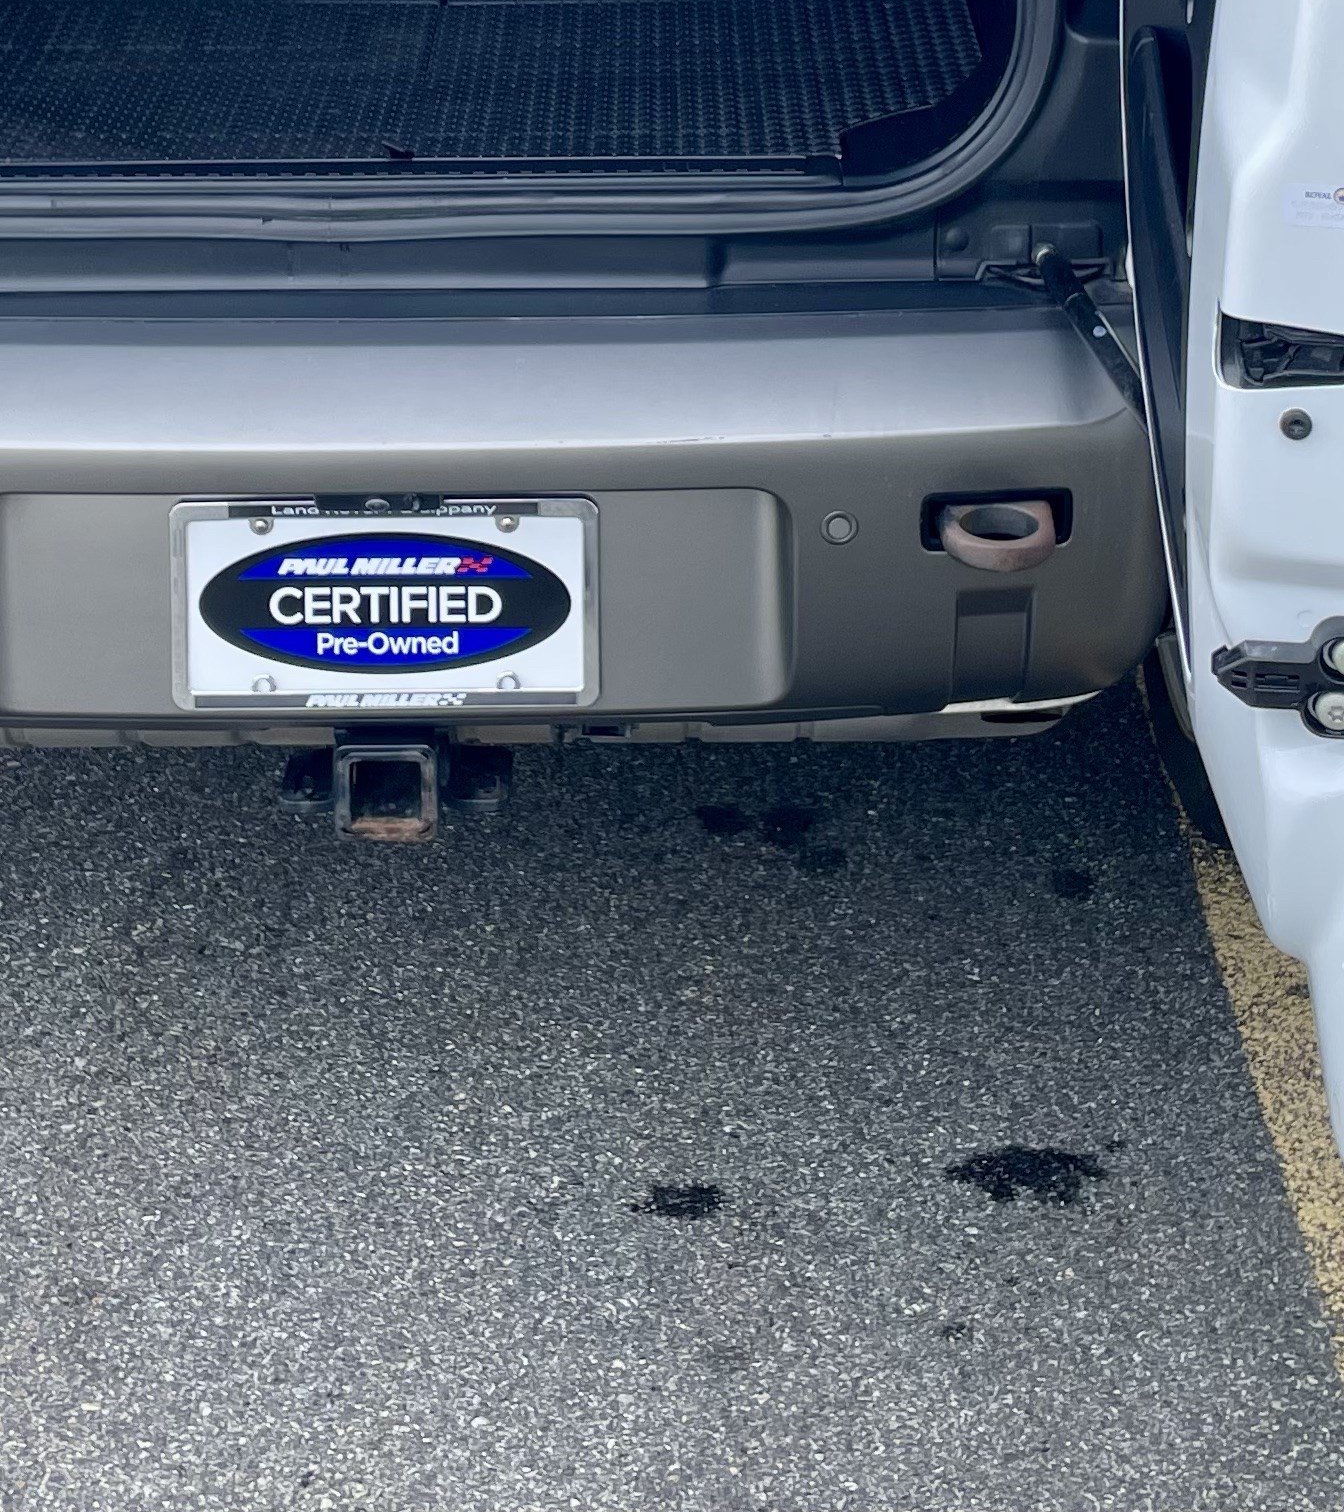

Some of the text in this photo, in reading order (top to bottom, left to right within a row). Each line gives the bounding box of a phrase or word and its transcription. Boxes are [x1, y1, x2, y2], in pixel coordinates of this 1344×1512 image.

[277, 557, 463, 576] PAUL MILLER
[268, 585, 503, 625] CERTIFIED
[316, 630, 460, 656] Pre-Owned
[305, 693, 443, 708] PAUL MILLER
